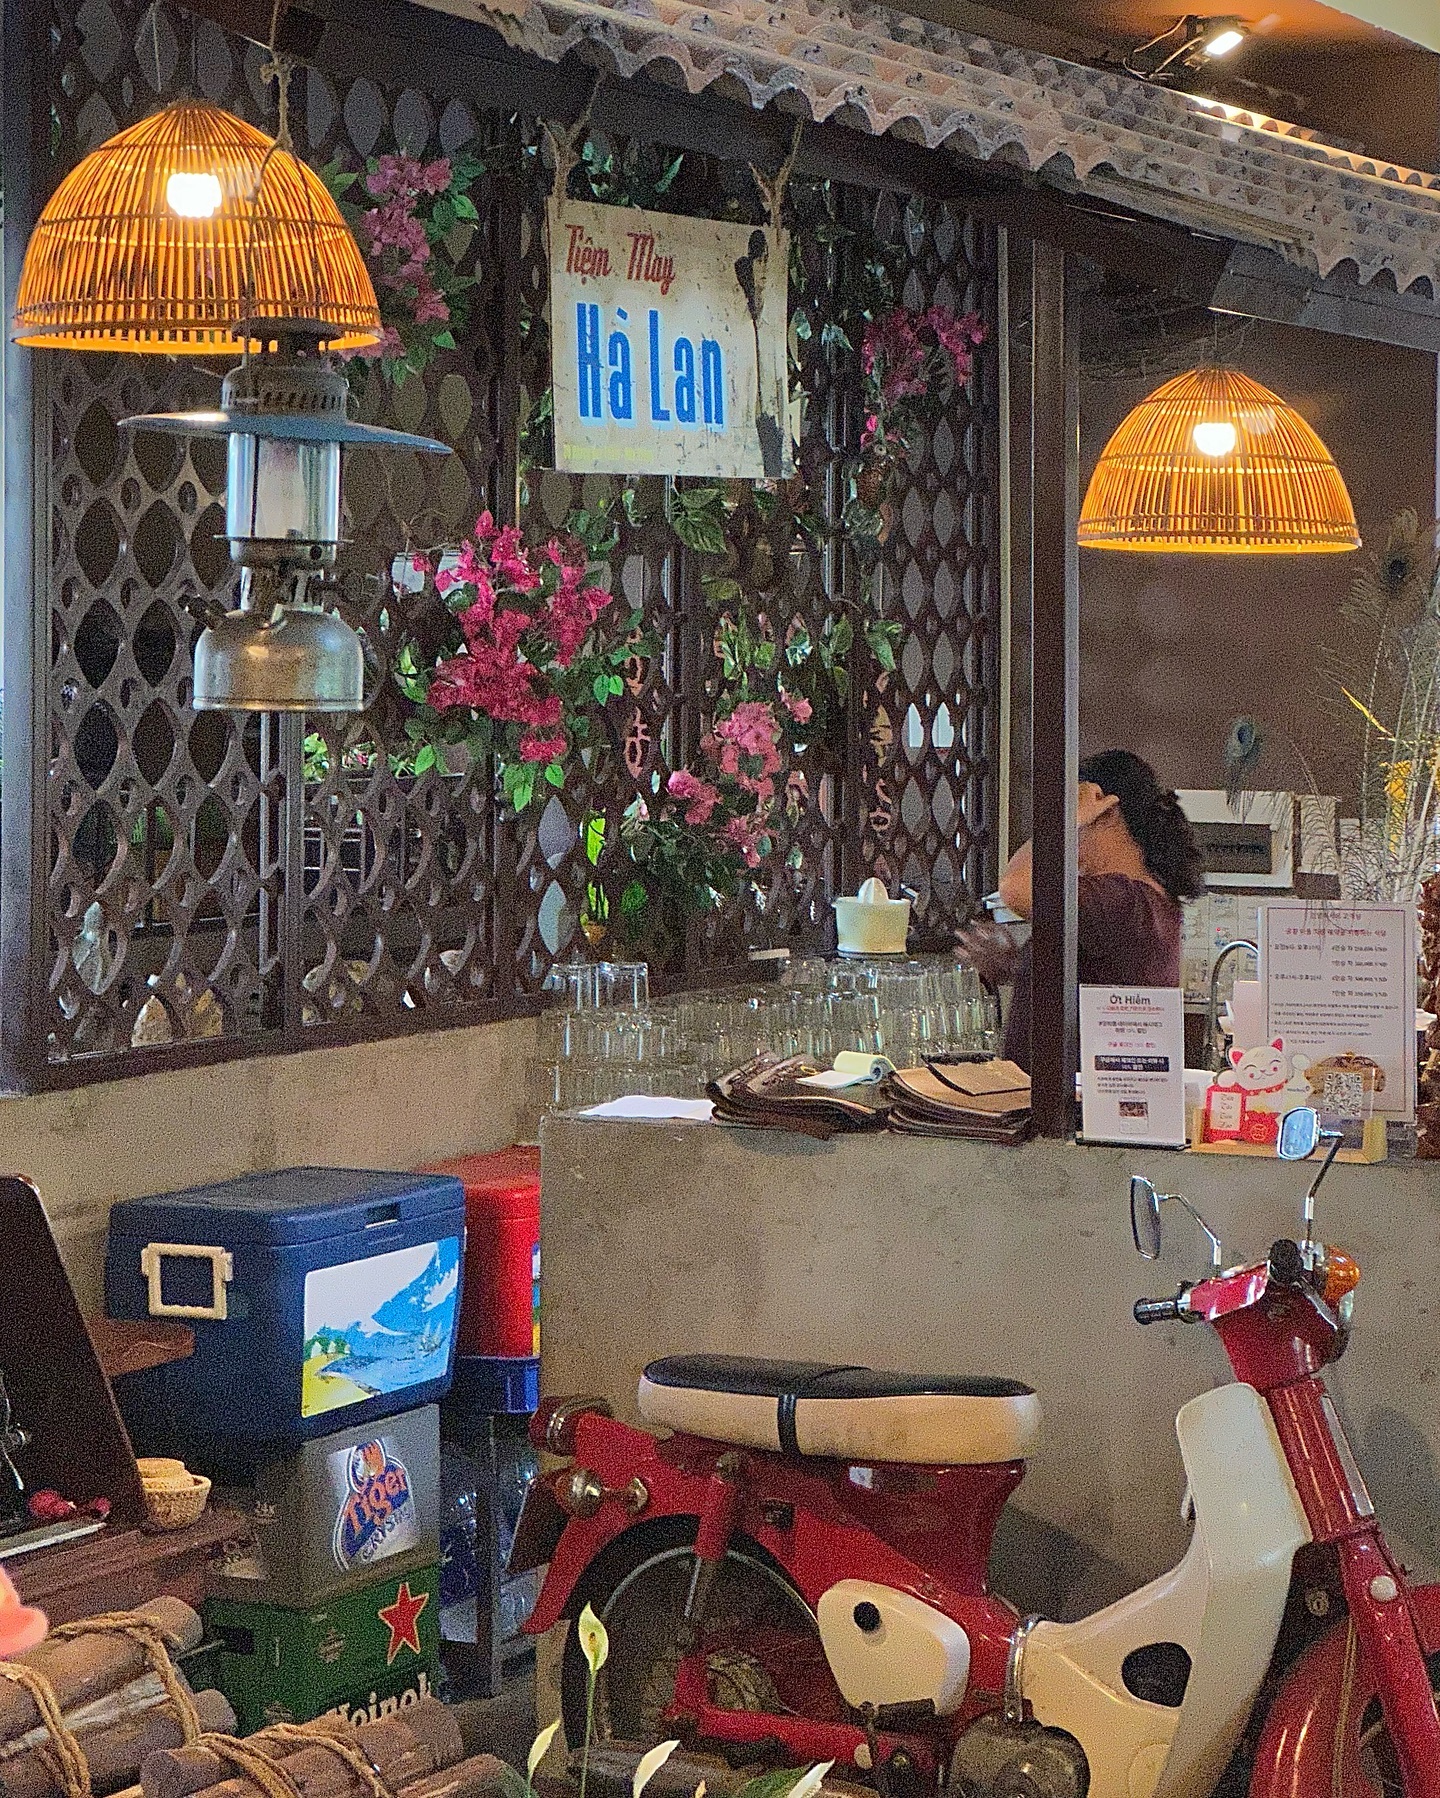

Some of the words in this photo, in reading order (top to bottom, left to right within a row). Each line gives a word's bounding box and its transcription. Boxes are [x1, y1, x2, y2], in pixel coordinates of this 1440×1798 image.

[564, 223, 613, 286] Tiệm
[626, 231, 675, 296] May
[576, 302, 634, 421] Hà
[648, 309, 725, 425] Lan
[343, 1467, 409, 1535] Tiger
